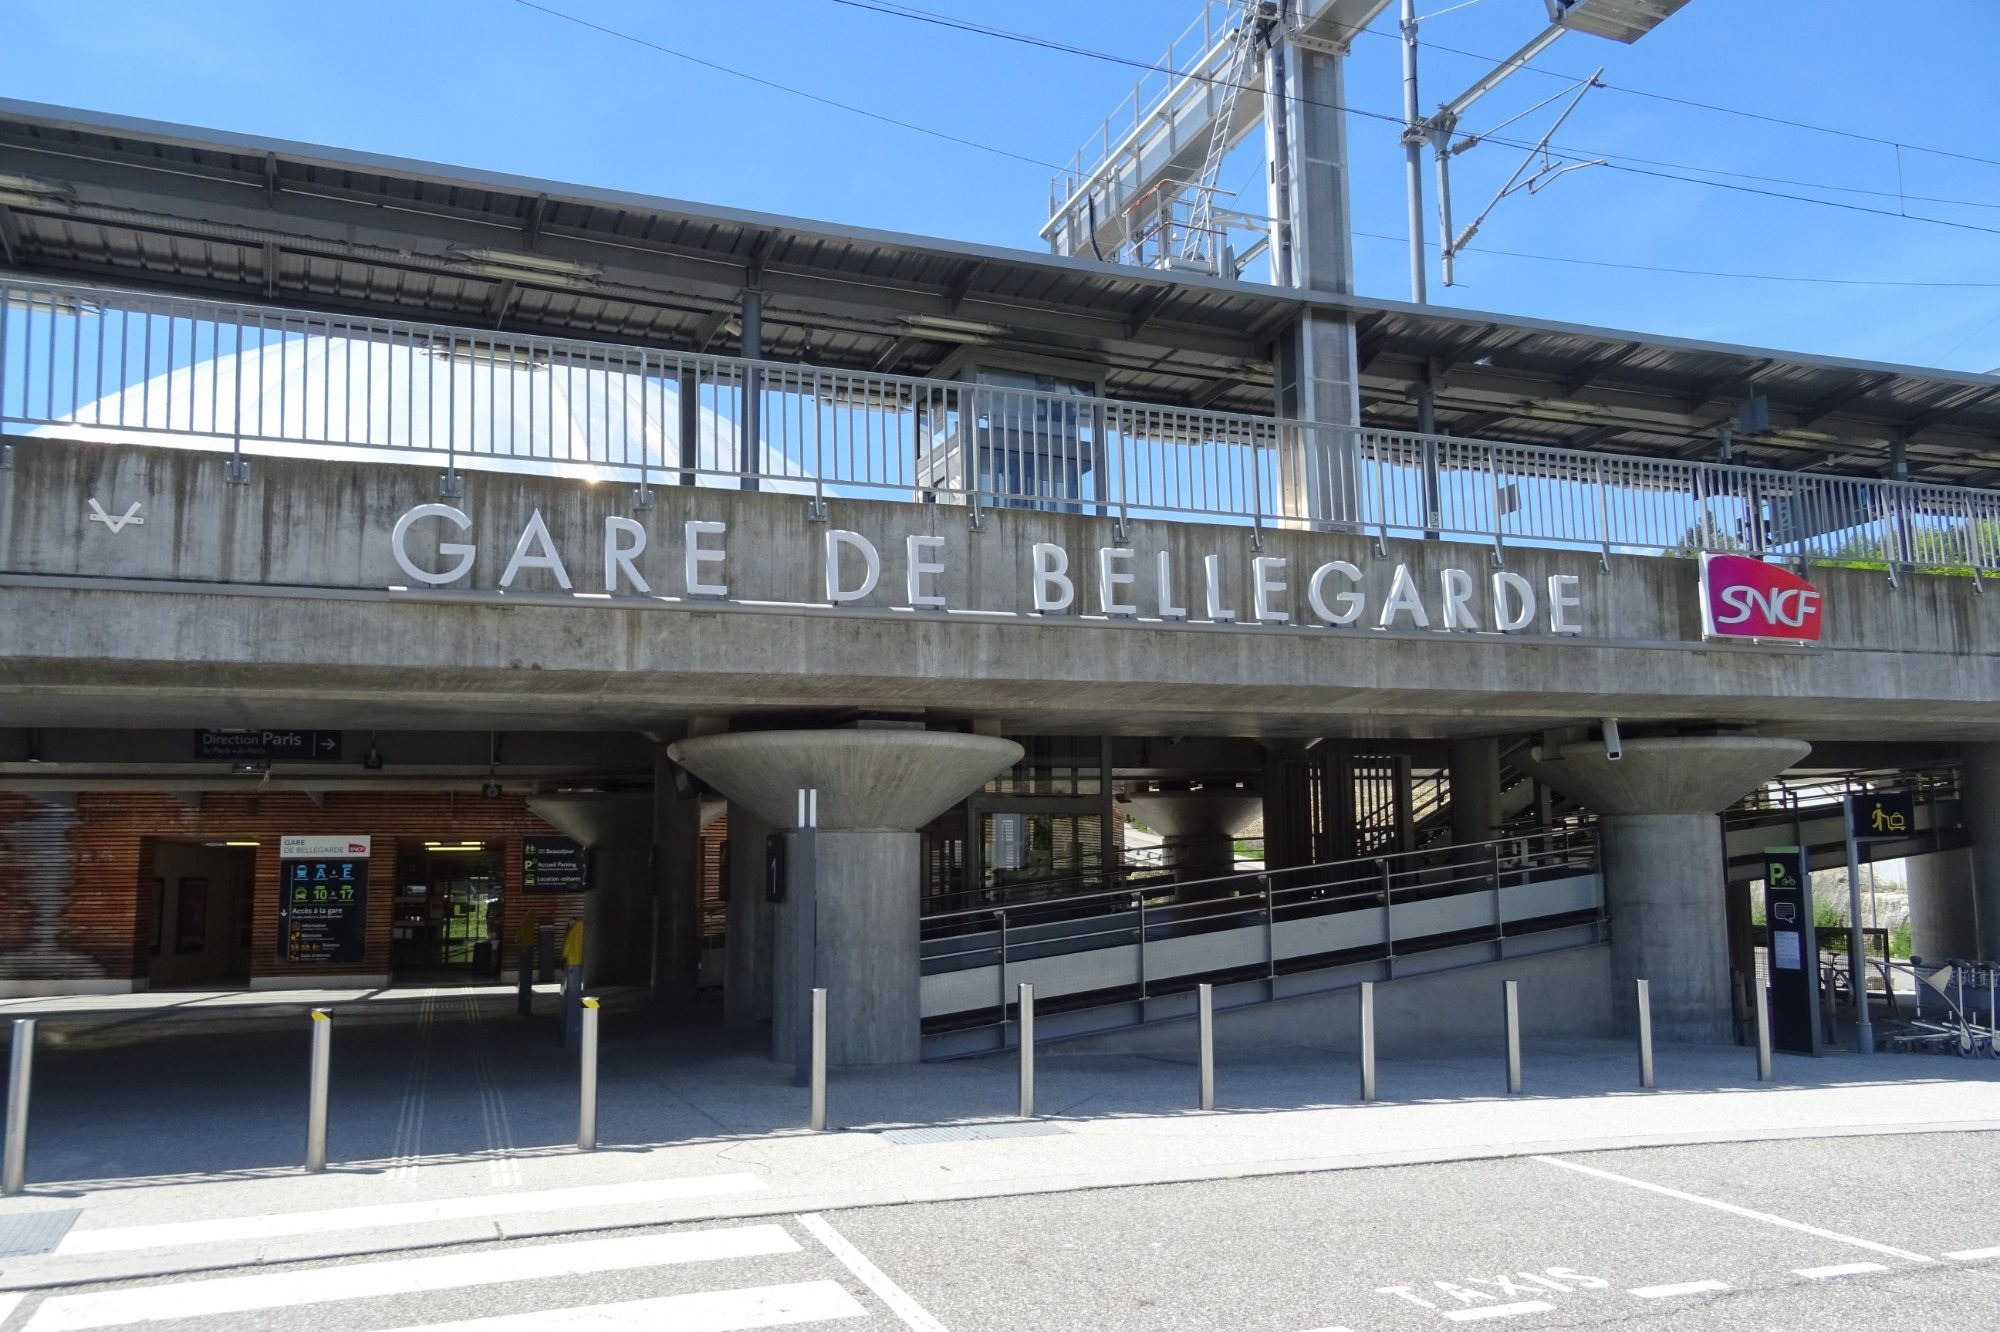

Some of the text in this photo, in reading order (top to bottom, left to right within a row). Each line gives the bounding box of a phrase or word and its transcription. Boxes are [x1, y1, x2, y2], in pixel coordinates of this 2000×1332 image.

[392, 503, 1582, 634] GARE DE BELLEGARDE
[1717, 585, 1820, 628] SNCF
[202, 731, 303, 746] Direction Paris
[316, 868, 325, 878] A
[343, 868, 351, 878] E
[525, 860, 533, 871] P
[1769, 863, 1785, 886] P
[313, 889, 328, 900] 10
[339, 889, 354, 900] 17
